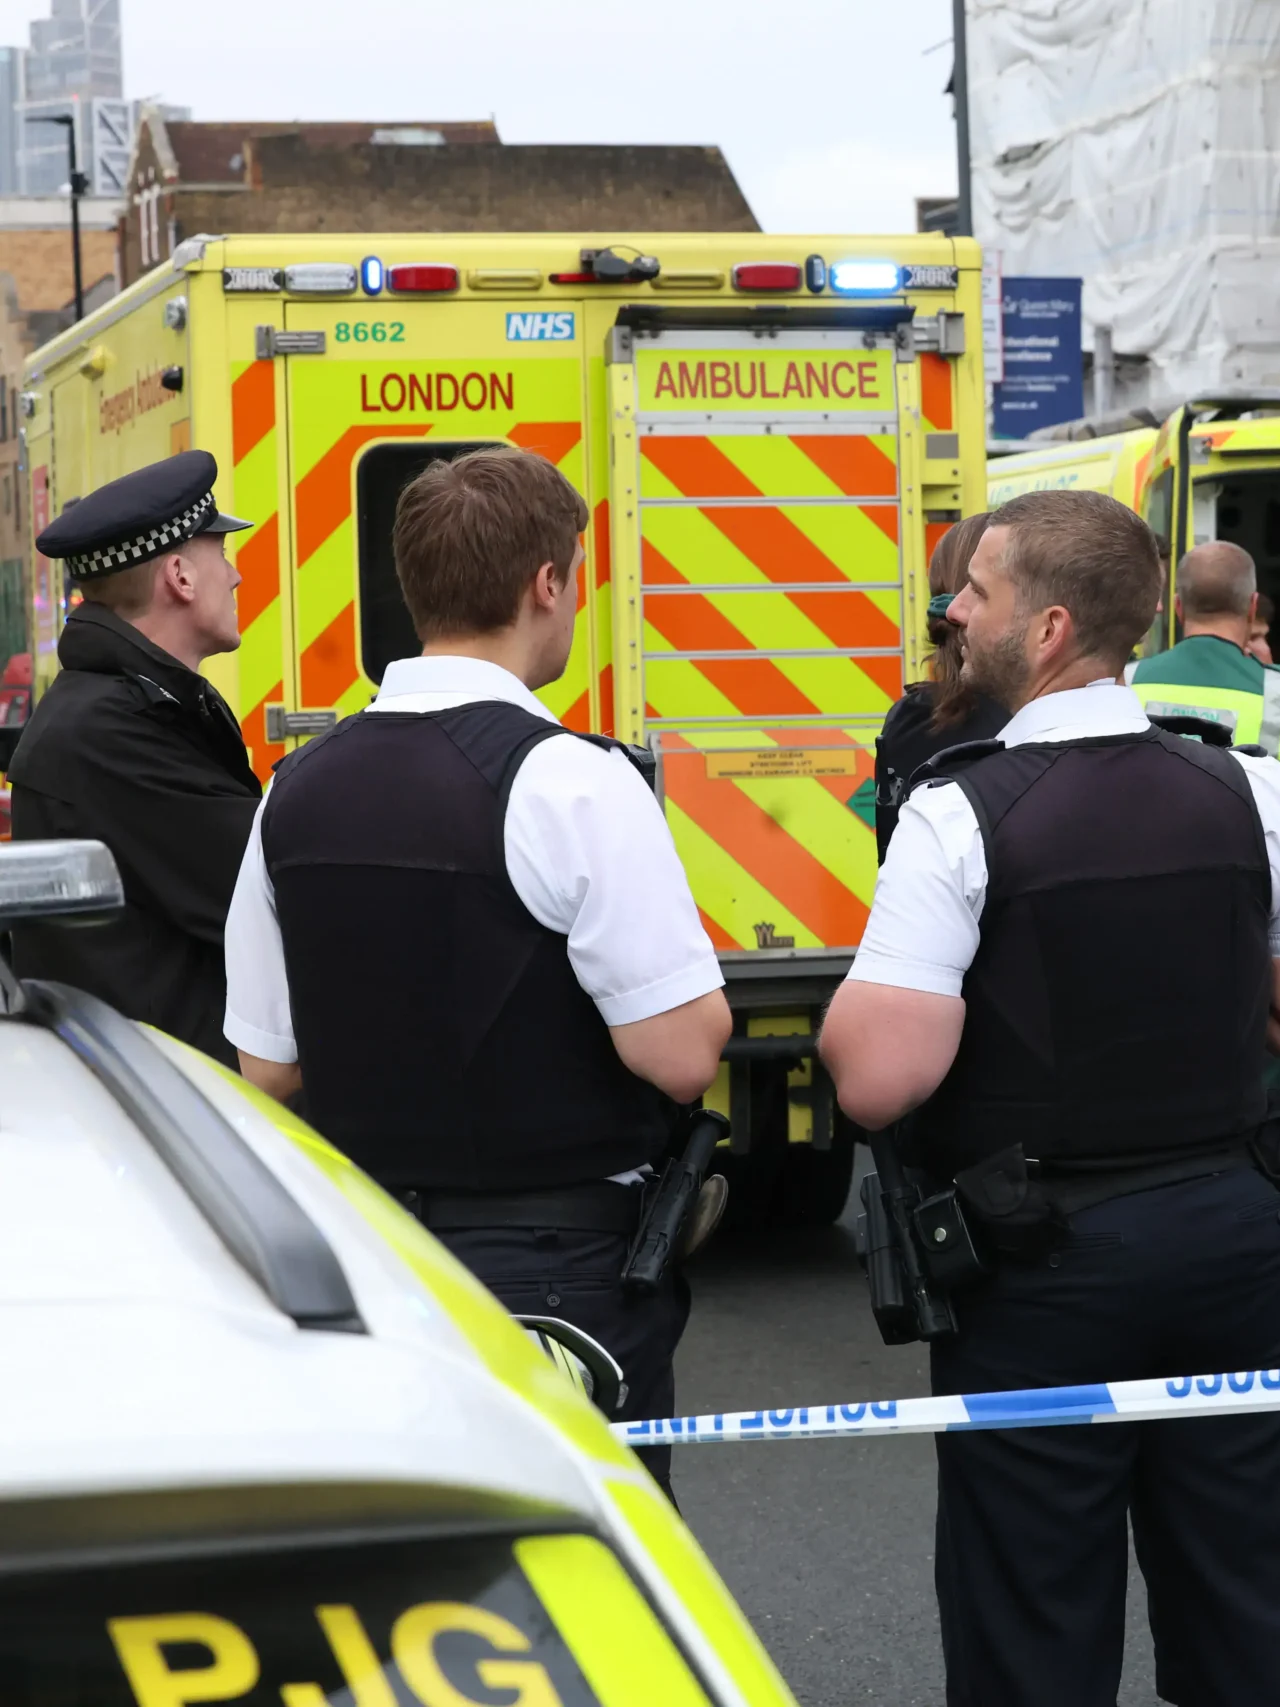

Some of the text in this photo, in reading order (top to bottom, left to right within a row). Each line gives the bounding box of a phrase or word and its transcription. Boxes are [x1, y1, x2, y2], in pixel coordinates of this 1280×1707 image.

[335, 322, 405, 342] 8662
[507, 313, 573, 340] NHS
[361, 372, 514, 412] LONDON
[654, 361, 879, 399] AMBULANCE
